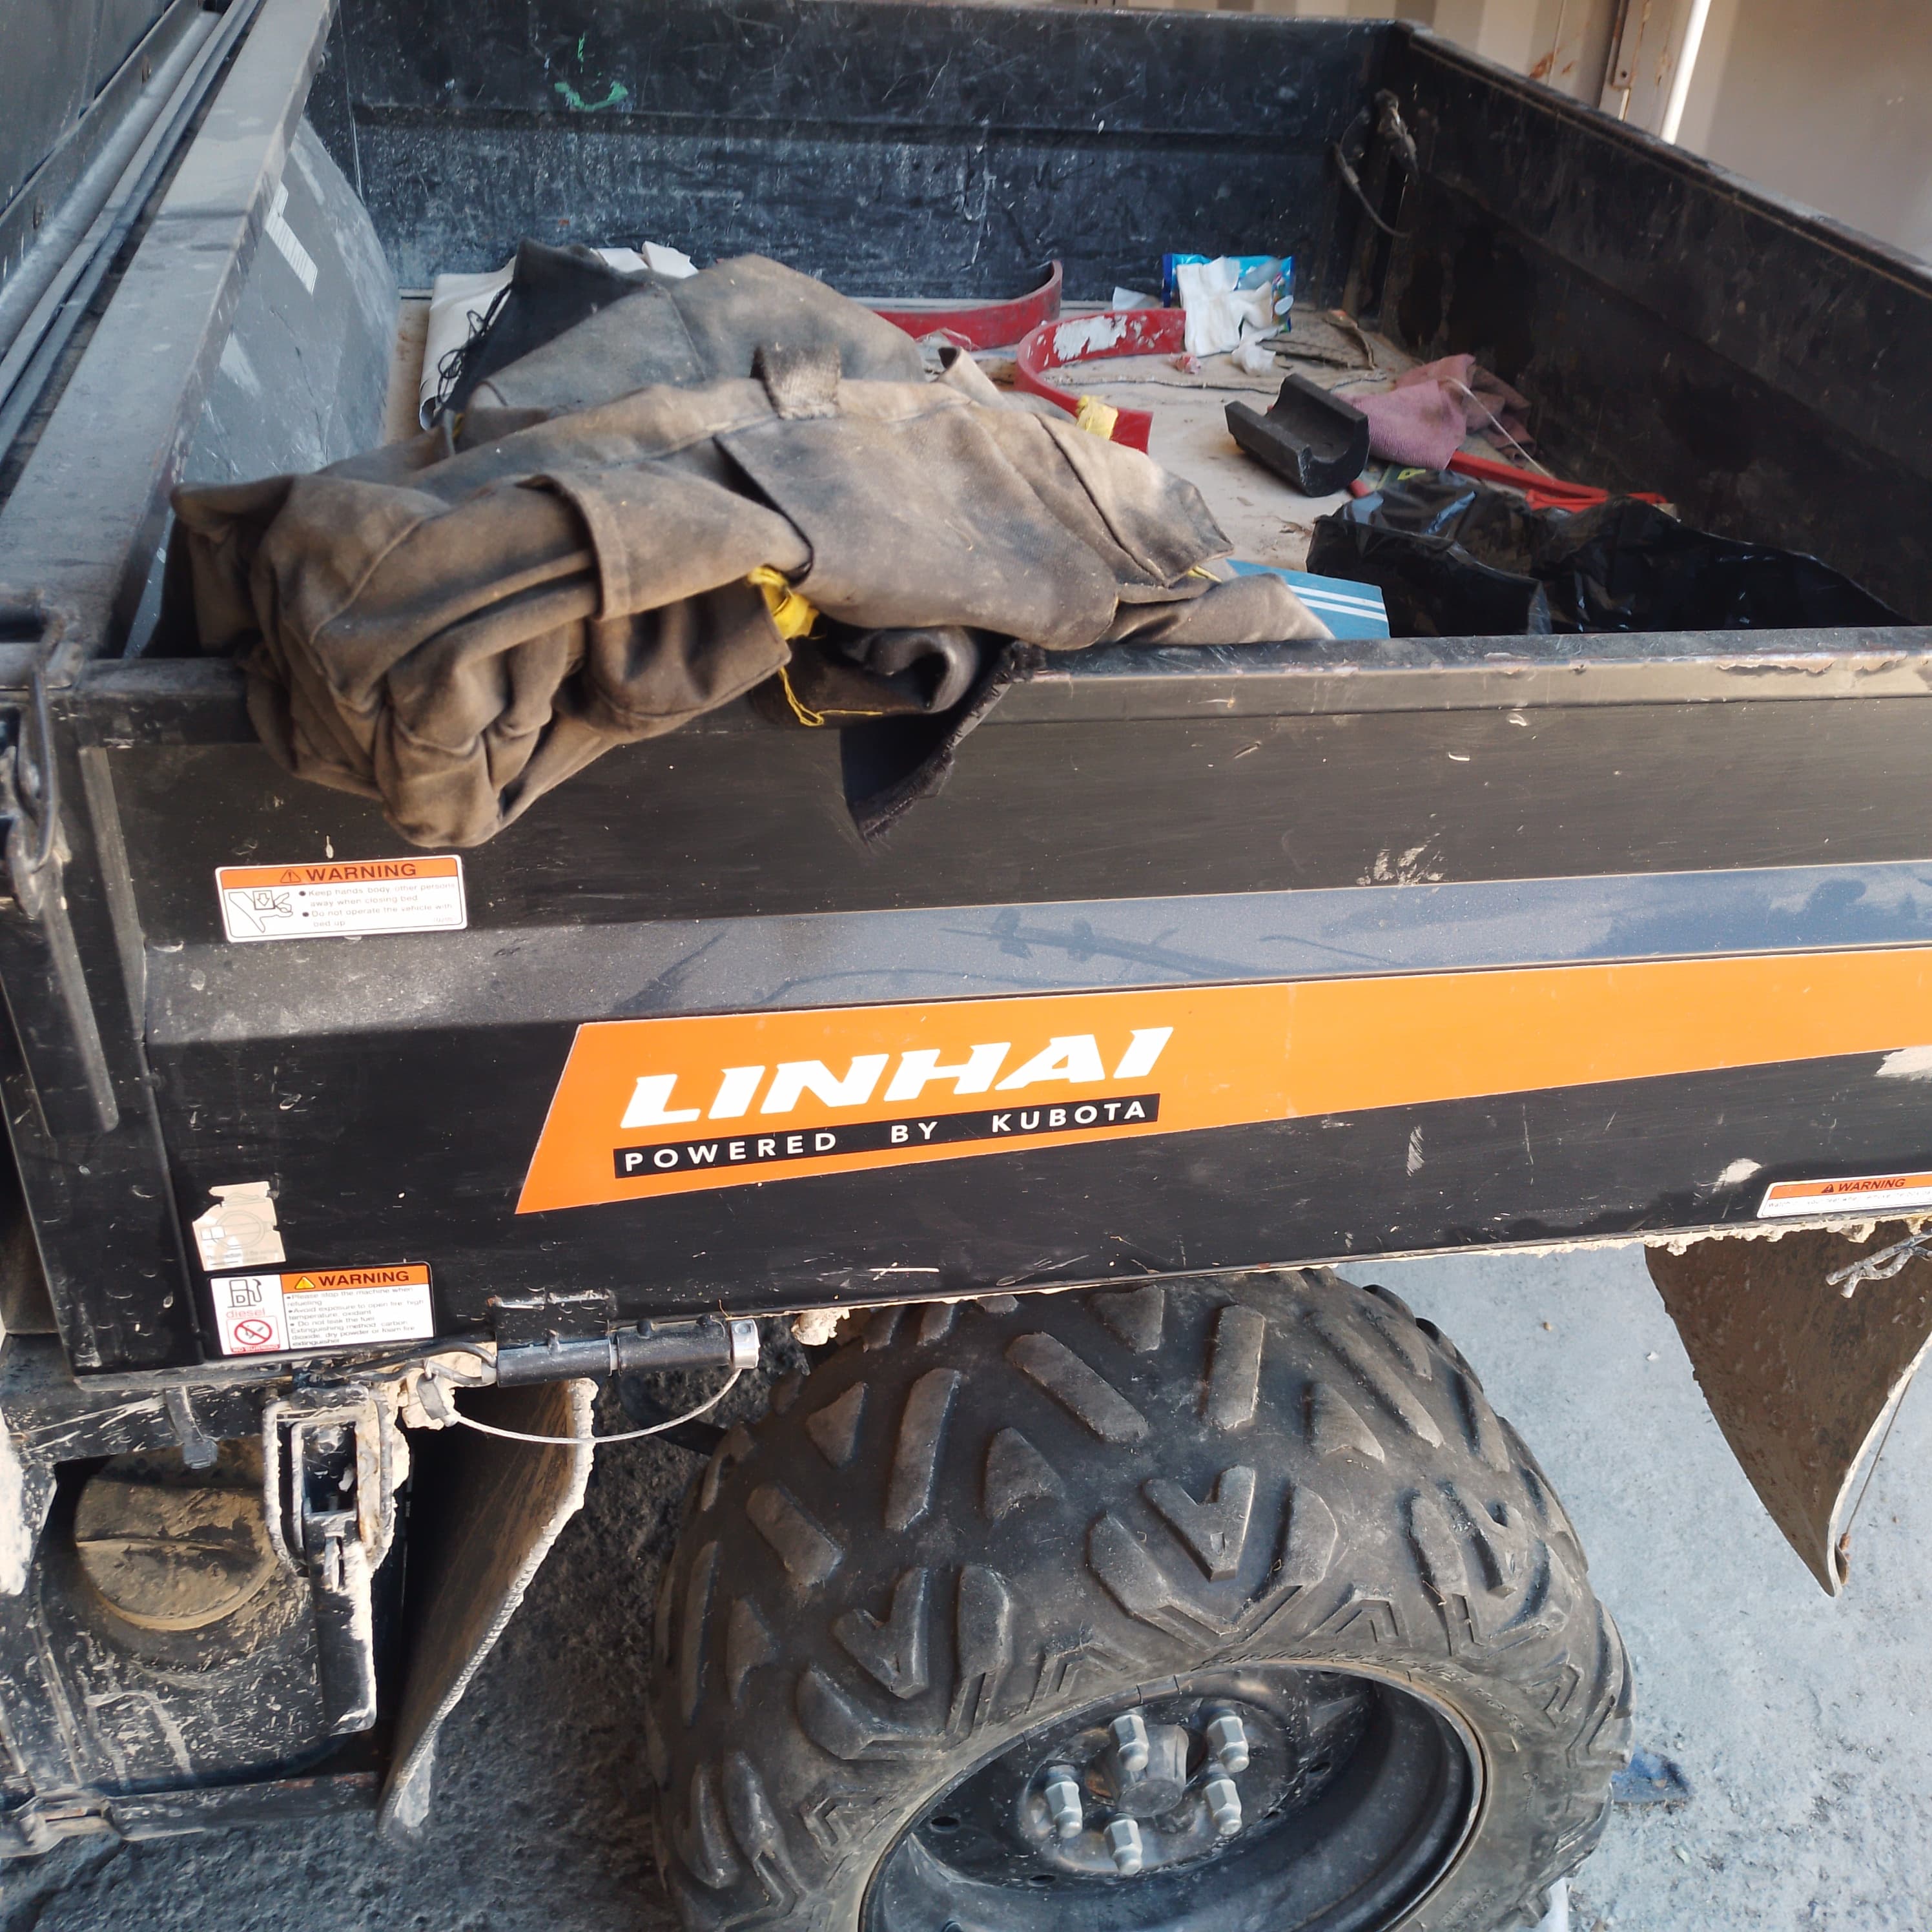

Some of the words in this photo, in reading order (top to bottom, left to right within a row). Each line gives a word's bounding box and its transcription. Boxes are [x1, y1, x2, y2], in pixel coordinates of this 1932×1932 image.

[306, 863, 417, 881] WARNING
[620, 1027, 1174, 1129] LINHAI
[625, 1132, 836, 1173] POWERED
[889, 1121, 940, 1144] BY
[992, 1100, 1147, 1134] KUBOTA
[1838, 1178, 1906, 1192] WARNING
[318, 1271, 409, 1287] WARNING
[236, 1295, 245, 1303] D
[226, 1308, 265, 1319] diesel
